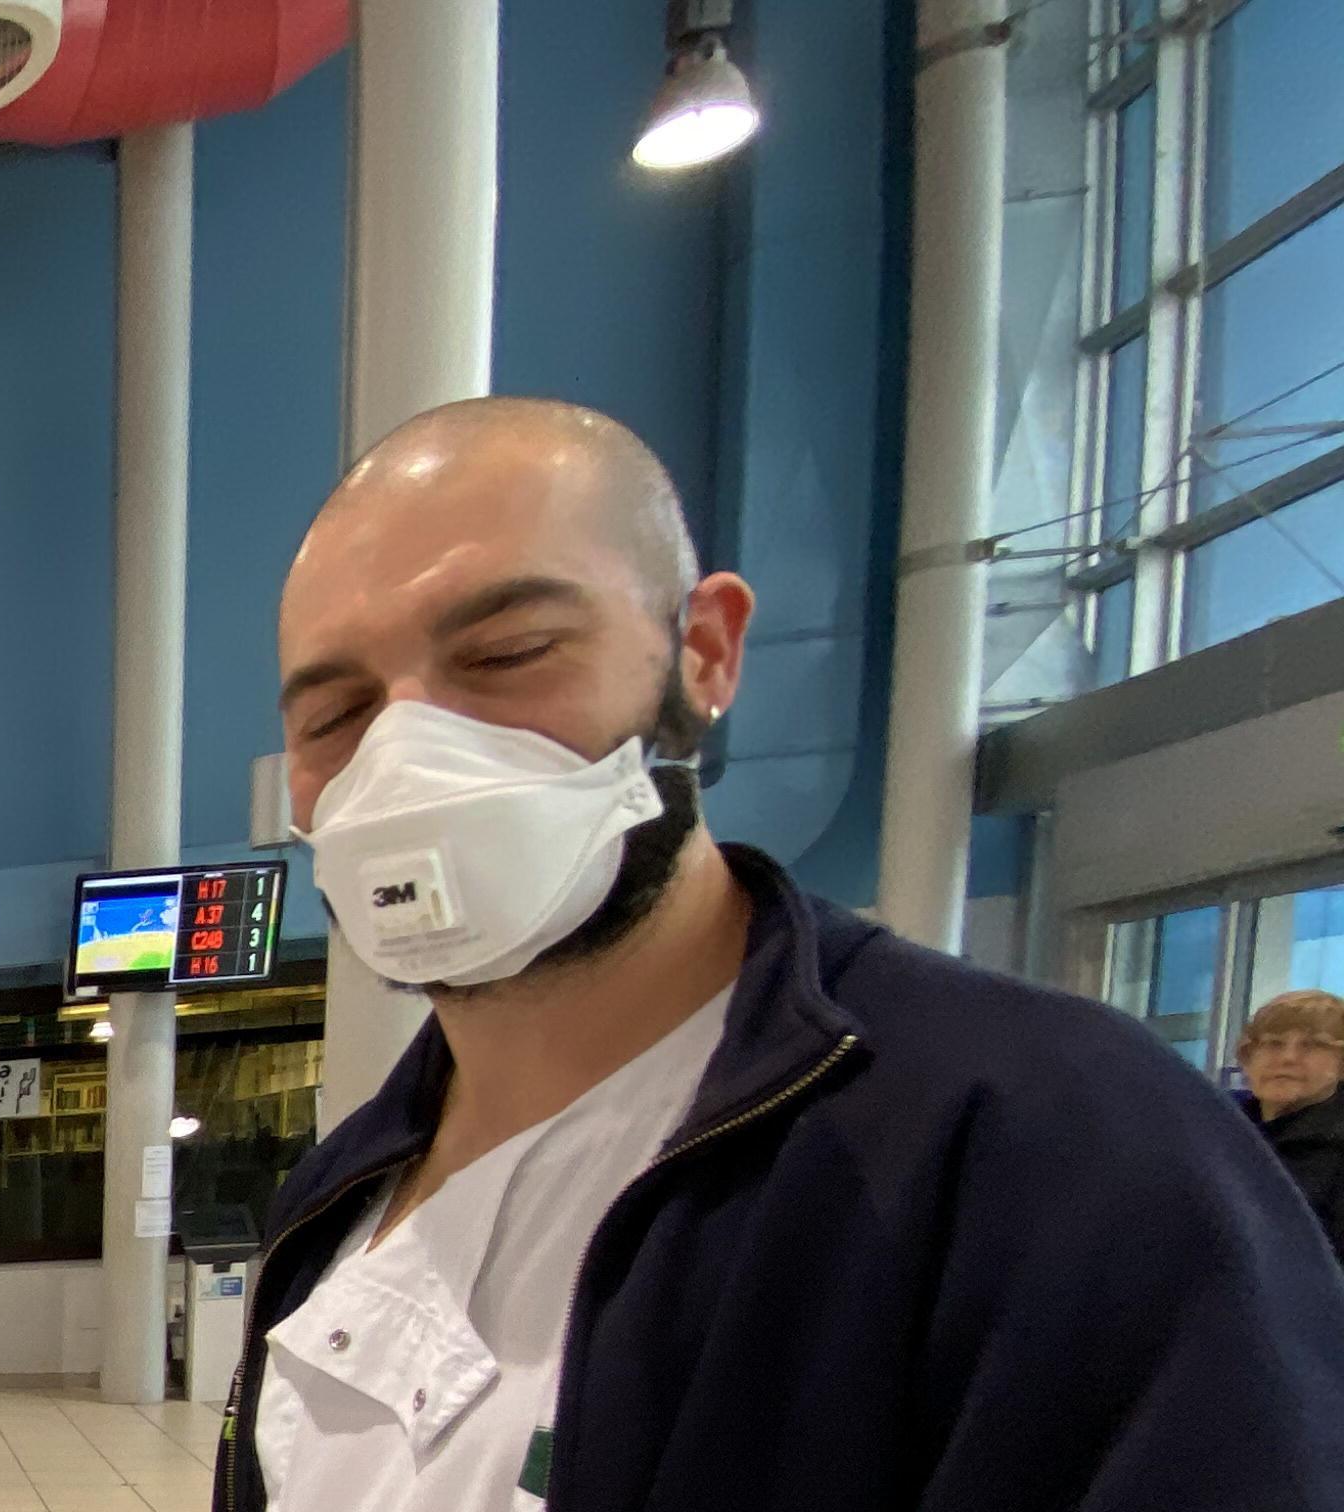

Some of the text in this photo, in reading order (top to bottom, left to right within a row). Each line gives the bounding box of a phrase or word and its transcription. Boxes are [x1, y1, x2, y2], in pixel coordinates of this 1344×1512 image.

[256, 877, 265, 896] 1
[372, 881, 416, 908] 3M
[251, 902, 263, 922] 4
[248, 928, 260, 948] 3
[248, 953, 257, 972] 1
